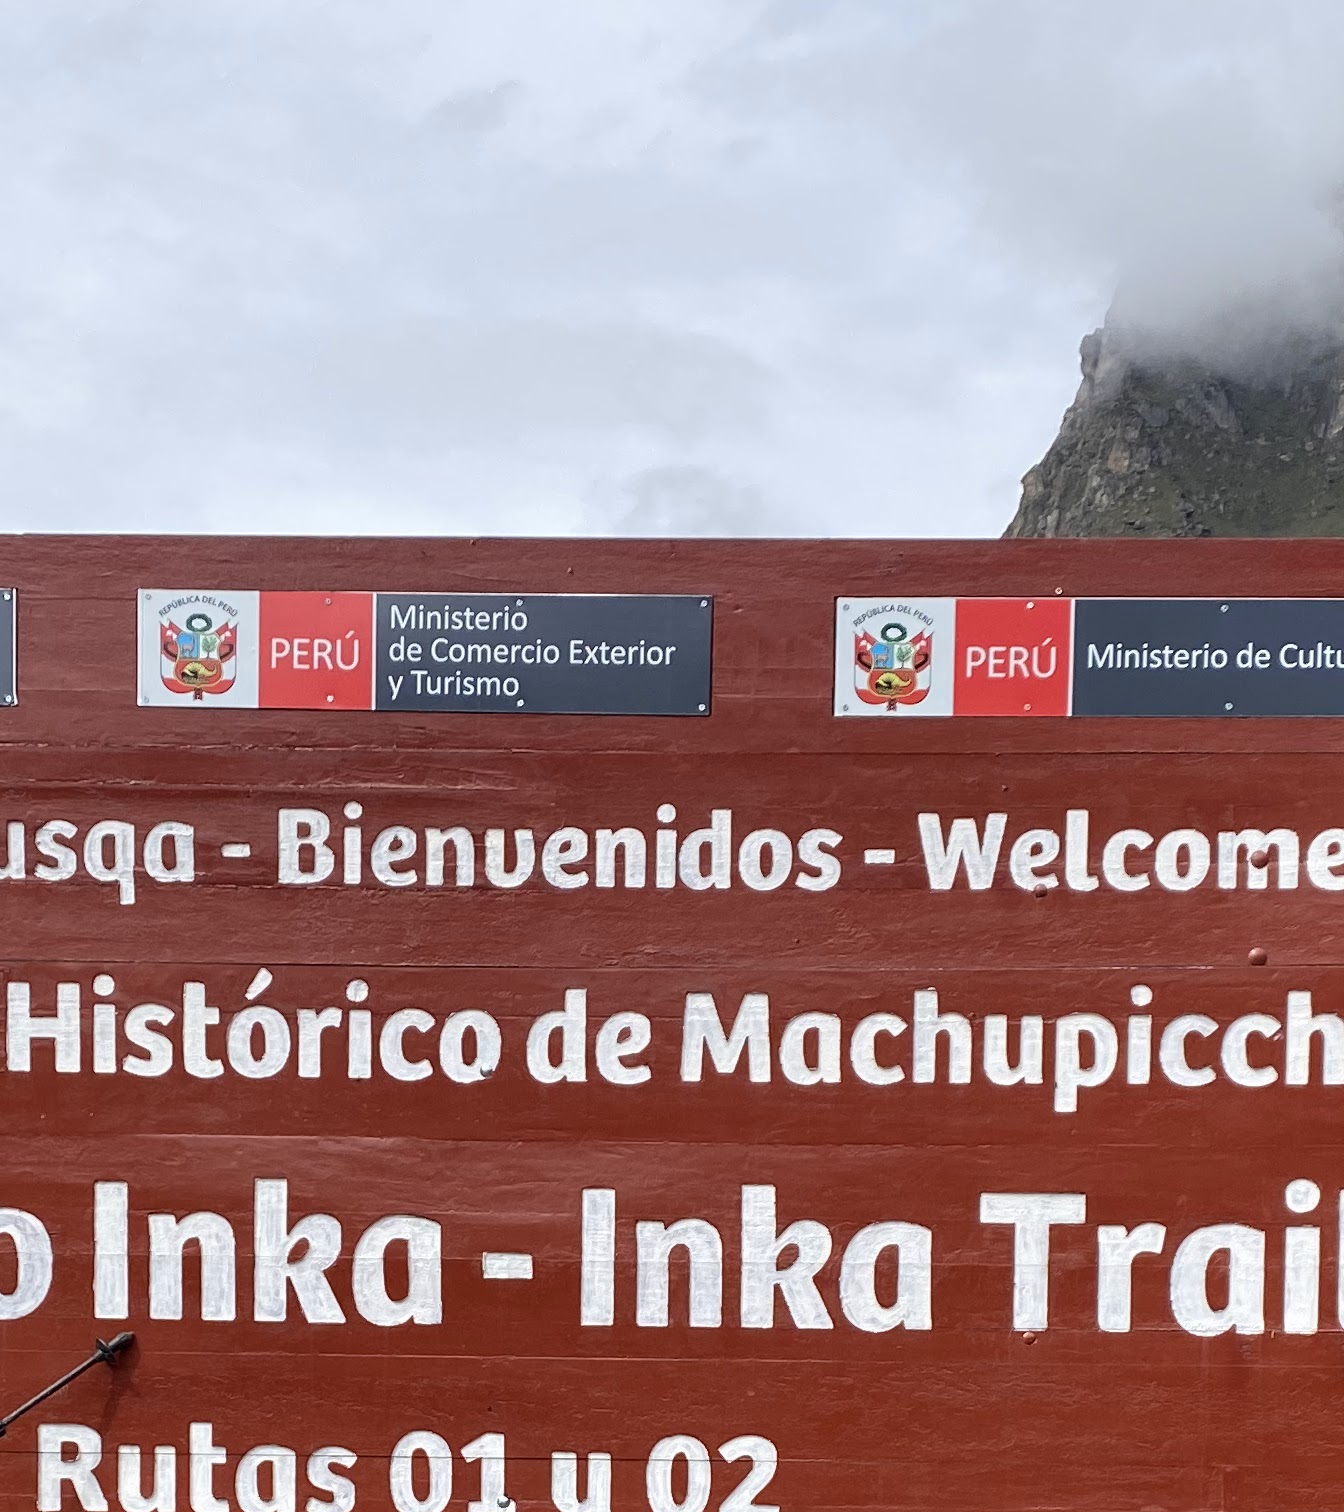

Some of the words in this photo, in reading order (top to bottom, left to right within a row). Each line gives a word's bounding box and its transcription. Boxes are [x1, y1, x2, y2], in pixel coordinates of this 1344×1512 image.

[158, 595, 201, 617] REPÚBLICA
[201, 596, 217, 607] DEL
[216, 600, 239, 617] PERÚ
[390, 604, 528, 631] Ministerio
[853, 603, 895, 627] REPÚBLICA
[897, 604, 913, 616] DEL
[913, 609, 934, 626] PERÚ
[271, 630, 359, 671] PERÚ
[389, 636, 423, 662] de
[430, 637, 560, 665] Comercio
[569, 639, 677, 666] Exterior
[965, 637, 1057, 679] PERÚ
[1087, 642, 1228, 670] Ministerio
[1236, 642, 1271, 669] de
[388, 676, 404, 700] y
[410, 670, 520, 697] Turismo
[222, 844, 251, 858] -
[278, 808, 843, 892] Bienvenidos
[863, 849, 896, 865] -
[6, 967, 502, 1084] Histórico
[526, 988, 652, 1085] de
[92, 1179, 443, 1327] Inka
[482, 1251, 534, 1280] -
[580, 1184, 933, 1334] Inka
